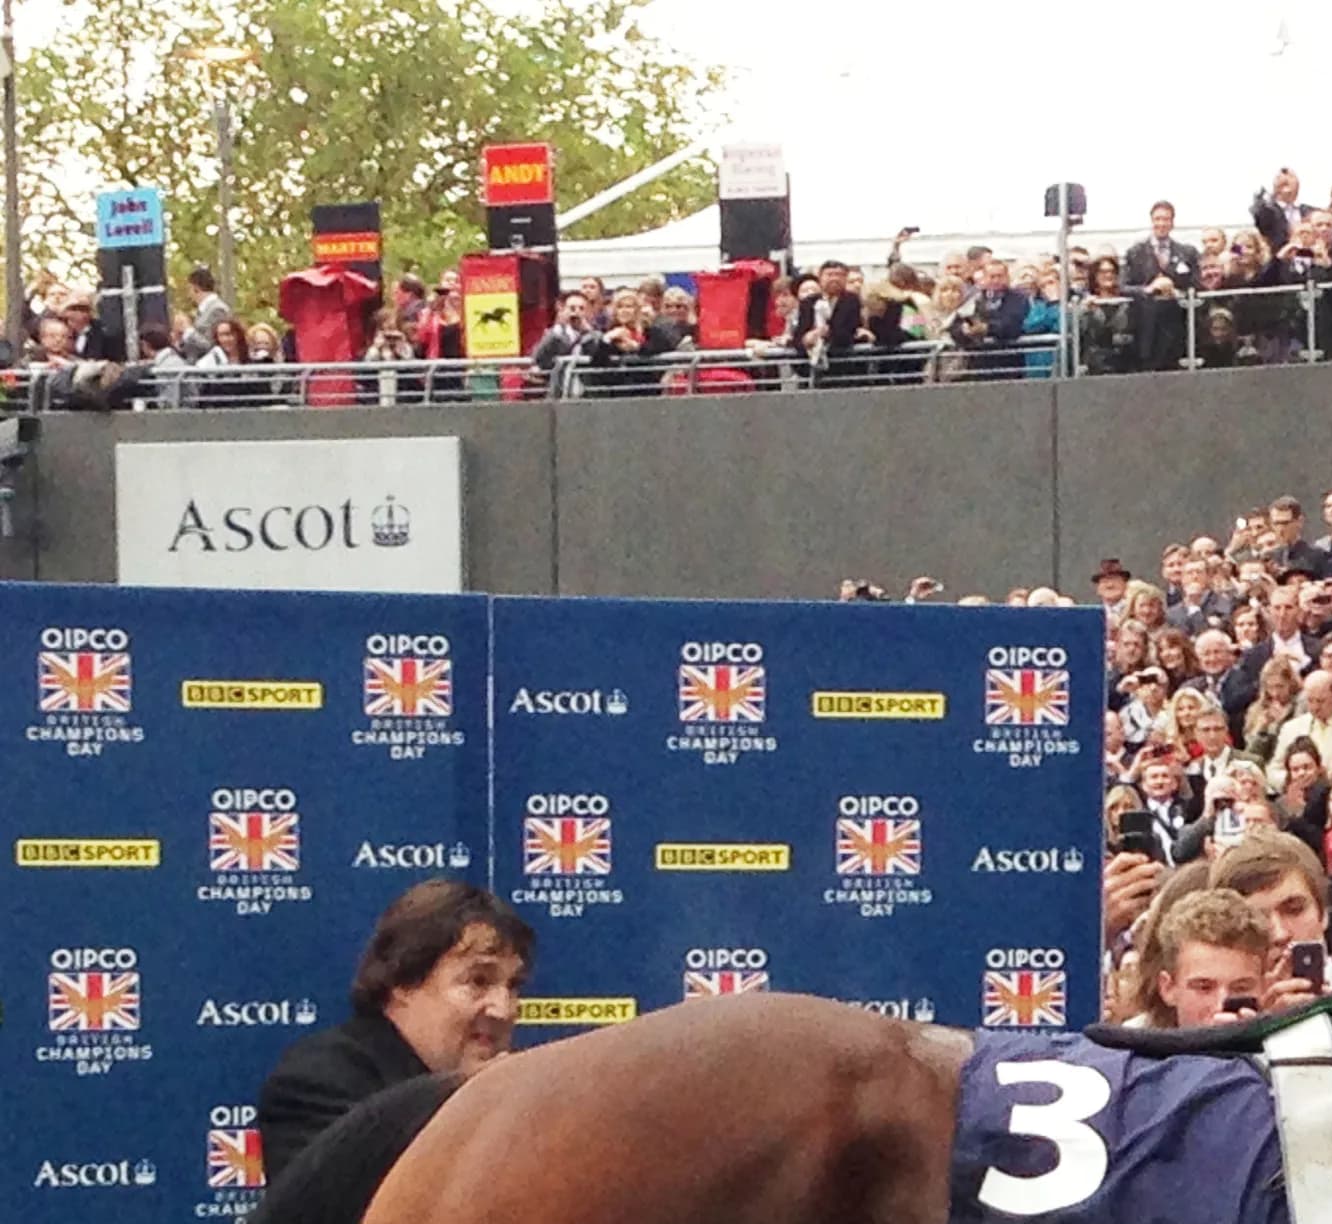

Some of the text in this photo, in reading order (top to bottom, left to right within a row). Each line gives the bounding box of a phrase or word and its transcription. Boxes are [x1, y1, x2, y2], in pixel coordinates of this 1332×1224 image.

[490, 163, 545, 185] ANDY
[168, 498, 357, 551] Ascot
[247, 686, 317, 703] SPORT
[511, 690, 601, 713] Ascot
[874, 697, 940, 713] SPORT
[27, 724, 143, 744] CHAMPIONS
[352, 728, 464, 748] CHAMPIONS
[667, 734, 776, 753] CHAMPIONS
[68, 742, 103, 756] DAY
[390, 745, 426, 760] DAY
[974, 737, 1079, 756] CHAMPIONS
[704, 750, 740, 765] DAY
[1009, 753, 1044, 767] DAY
[83, 844, 153, 861] SPORT
[355, 844, 444, 867] Ascot
[718, 848, 784, 864] SPORT
[973, 848, 1058, 871] Ascot
[198, 883, 311, 904] CHAMPIONS
[512, 887, 622, 906] CHAMPIONS
[824, 887, 931, 906] CHAMPIONS
[237, 900, 272, 915] DAY
[551, 902, 585, 917] DAY
[861, 902, 895, 917] DAY
[198, 1001, 289, 1024] Ascot
[564, 1002, 631, 1018] SPORT
[37, 1043, 152, 1063] CHAMPIONS
[78, 1060, 112, 1075] DAY
[210, 1104, 257, 1127] QIP
[978, 1059, 1110, 1215] 3
[35, 1162, 128, 1186] Ascot
